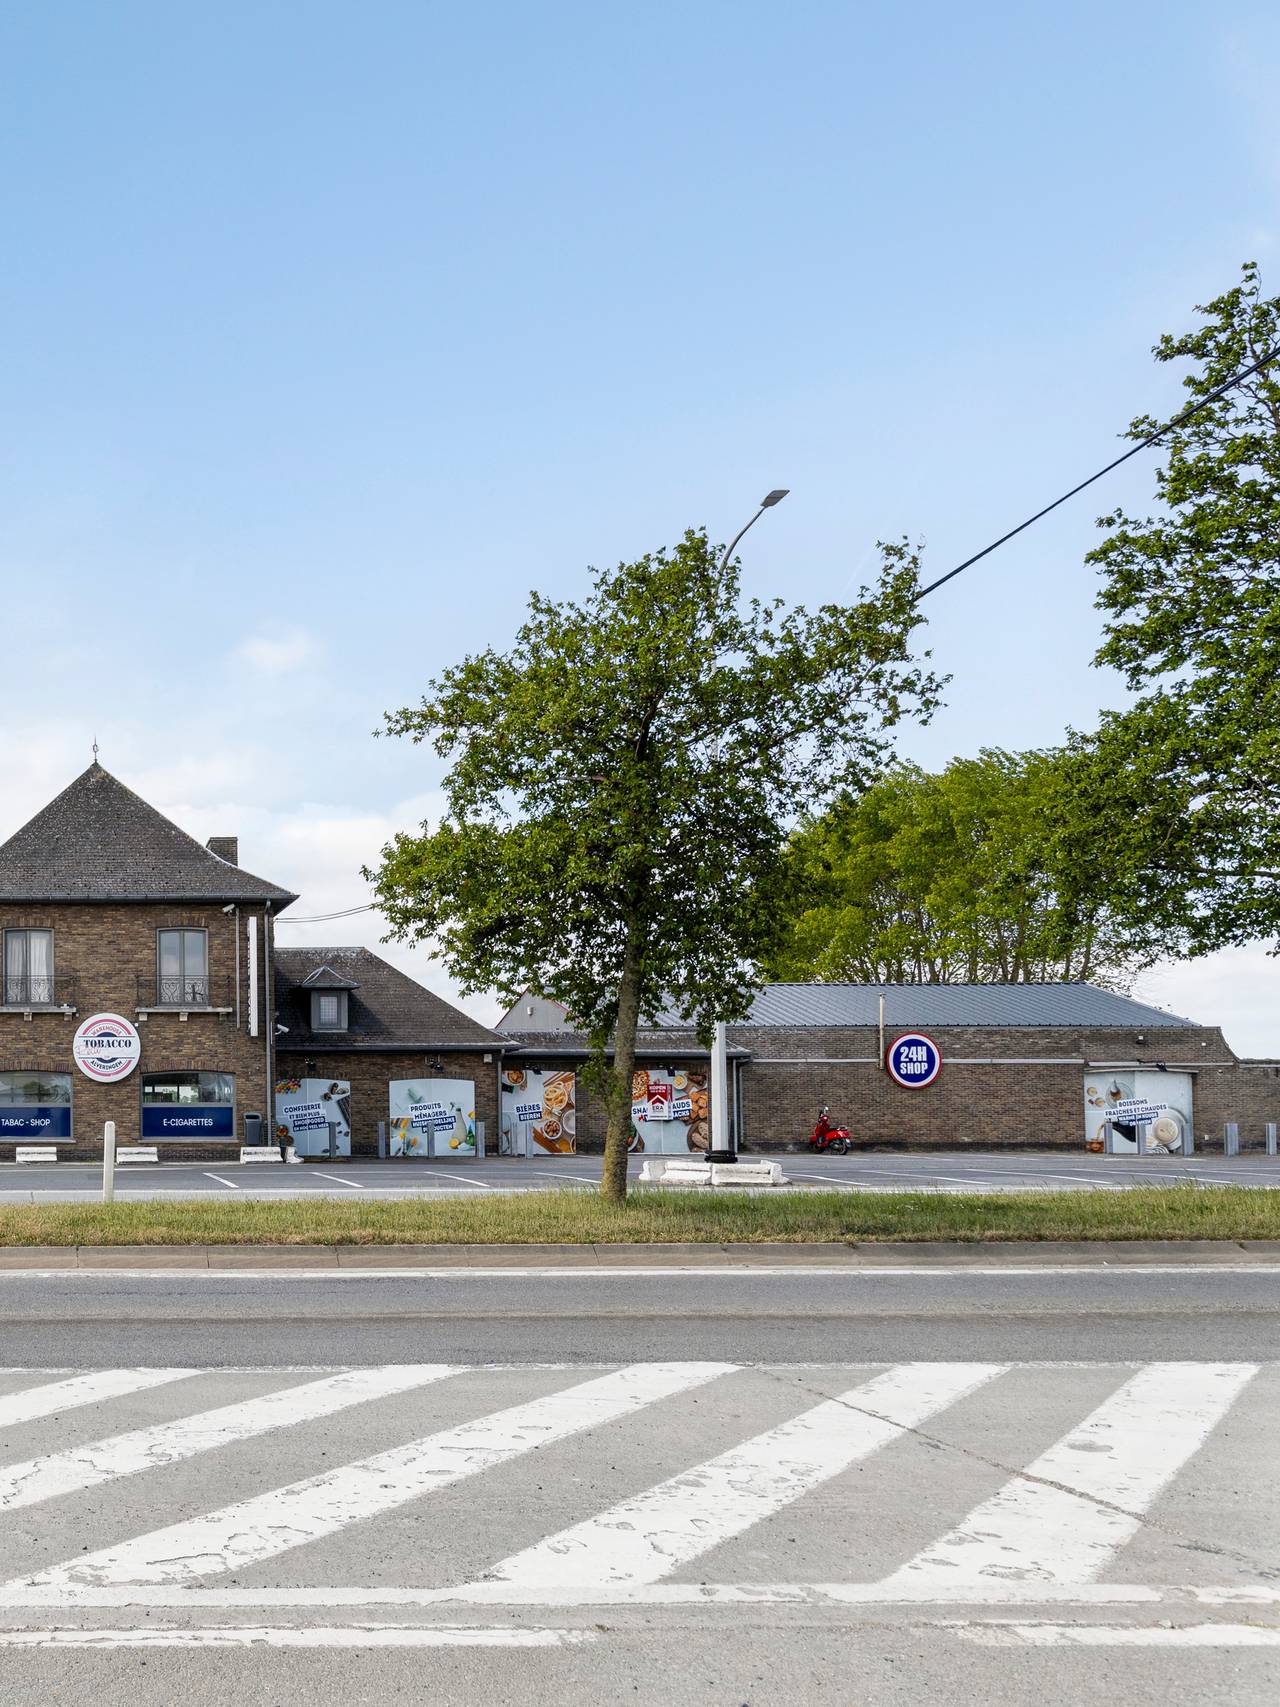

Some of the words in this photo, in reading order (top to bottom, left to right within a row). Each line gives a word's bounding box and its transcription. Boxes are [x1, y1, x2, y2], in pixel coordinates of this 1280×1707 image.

[91, 1025, 122, 1036] WAREHOUSE
[84, 1039, 132, 1048] TOBACCO
[900, 1046, 927, 1062] 24H
[900, 1062, 928, 1075] SHOP
[284, 1103, 321, 1113] CONFISERIE
[410, 1102, 442, 1112] PRODUITS
[515, 1103, 541, 1113] BIÈRES
[632, 1107, 648, 1115] SNA
[672, 1101, 691, 1110] AUDS
[1118, 1099, 1148, 1108] BOISSONS
[1141, 1104, 1167, 1112] CHAUDES
[308, 1110, 320, 1118] PLUS
[414, 1110, 447, 1120] MÉNAGERS
[520, 1113, 541, 1121] BIEREN
[1, 1118, 24, 1126] TABAC
[30, 1118, 51, 1126] SHOP
[163, 1118, 214, 1127] E-CIGARETTES
